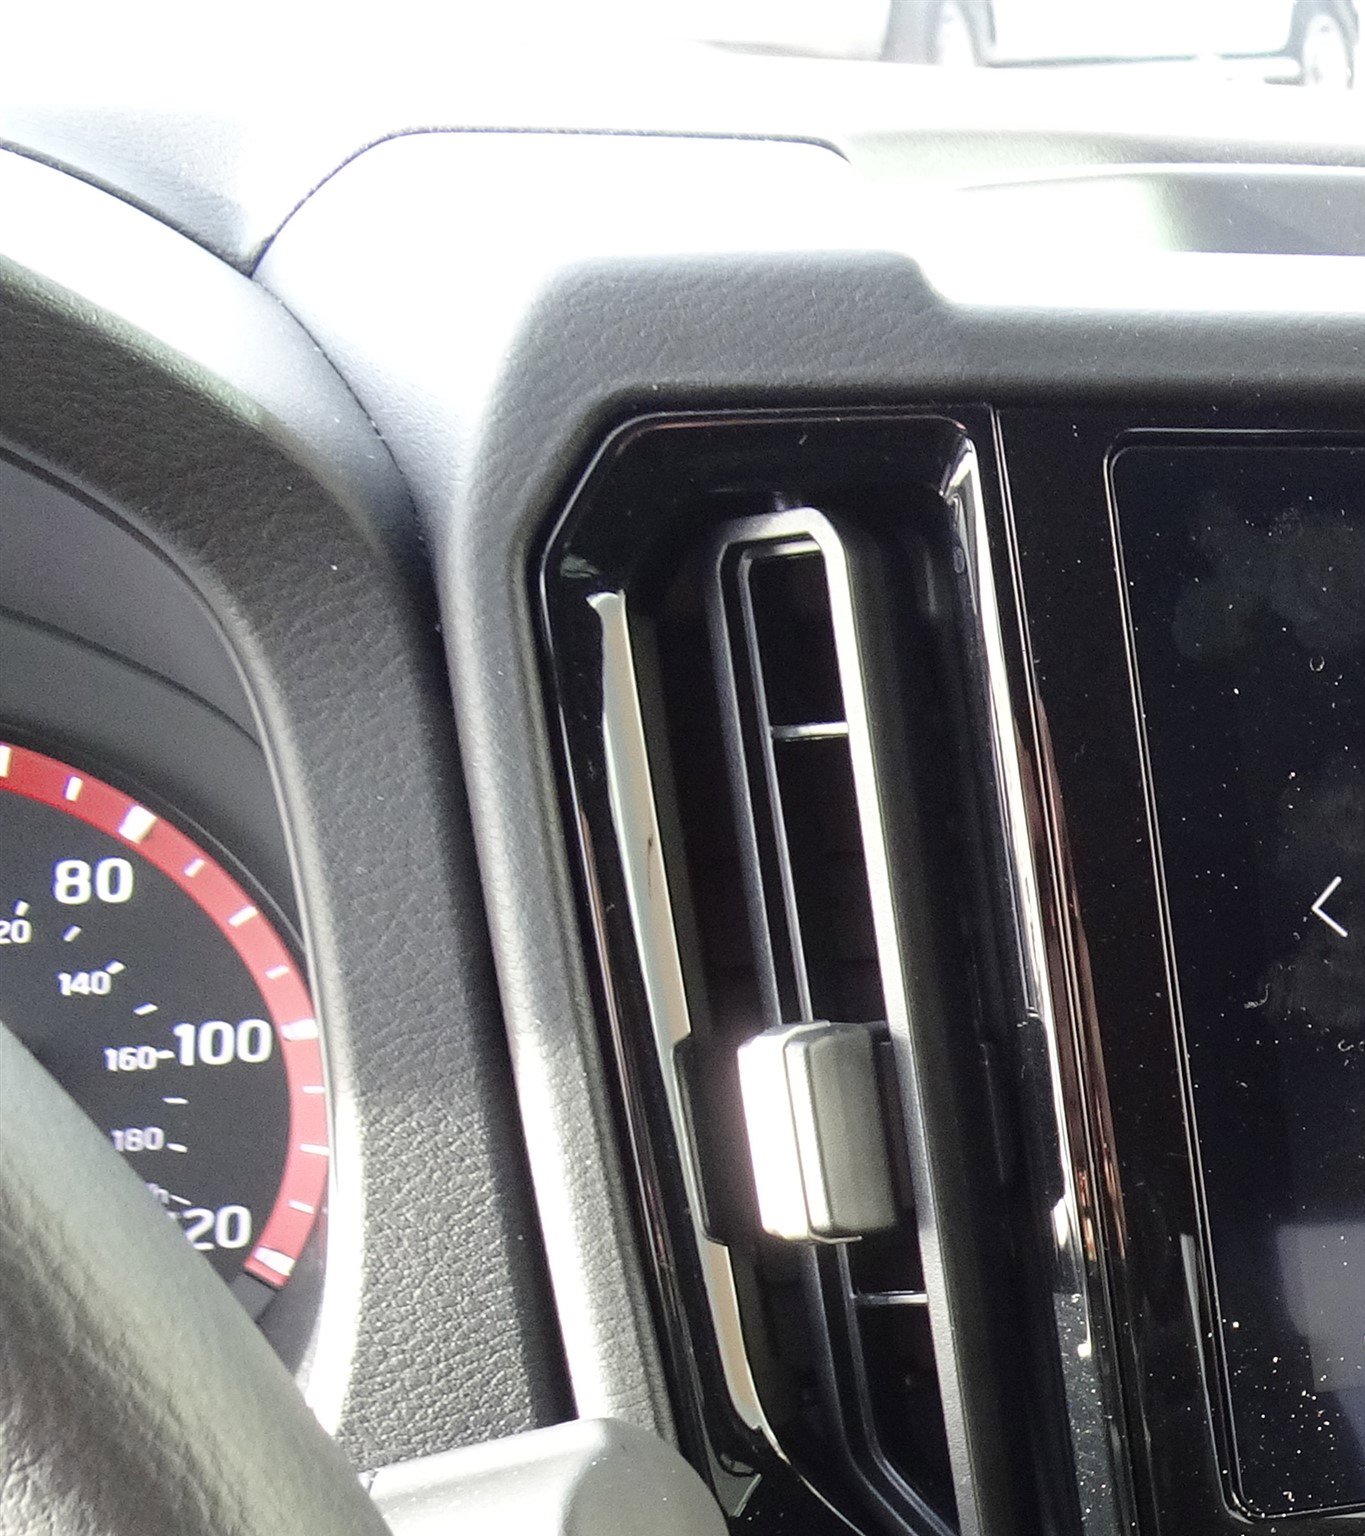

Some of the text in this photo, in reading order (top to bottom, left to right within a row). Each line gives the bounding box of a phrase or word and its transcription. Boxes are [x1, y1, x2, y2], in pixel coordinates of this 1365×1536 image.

[53, 857, 134, 904] 80
[0, 919, 32, 945] 20
[57, 970, 111, 996] 140
[172, 1019, 272, 1066] 100
[104, 1045, 157, 1072] 160
[111, 1126, 165, 1153] 180
[165, 1204, 252, 1250] 20
